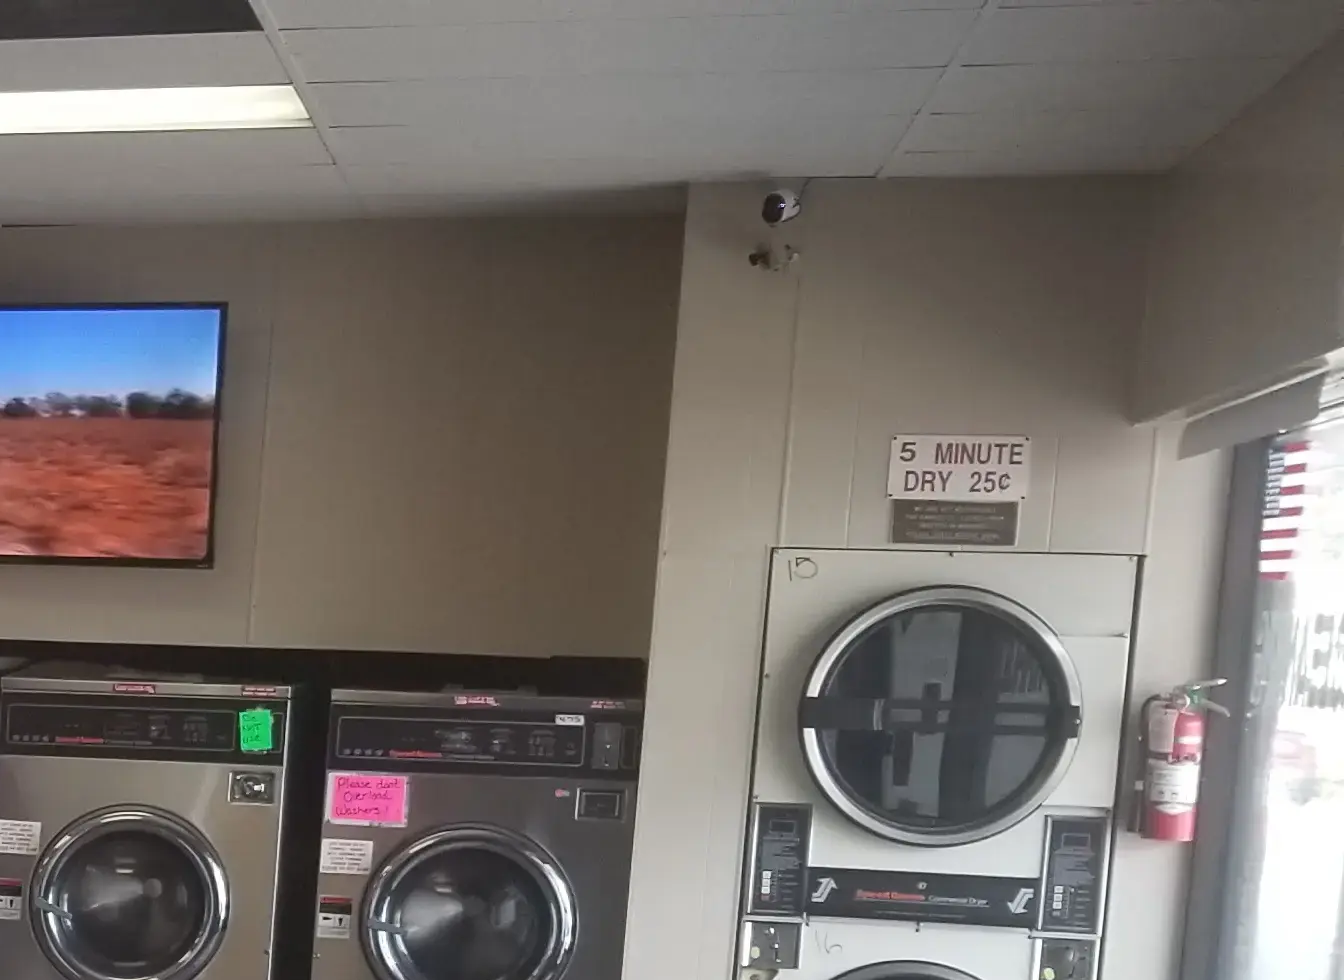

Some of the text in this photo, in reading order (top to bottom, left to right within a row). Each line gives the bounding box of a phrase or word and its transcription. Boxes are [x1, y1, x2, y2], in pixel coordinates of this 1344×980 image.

[899, 442, 1024, 465] 5 MINUTE
[904, 470, 1011, 493] DRY 25¢
[788, 557, 818, 582] 15
[338, 777, 371, 790] Please
[814, 927, 843, 955] 16
